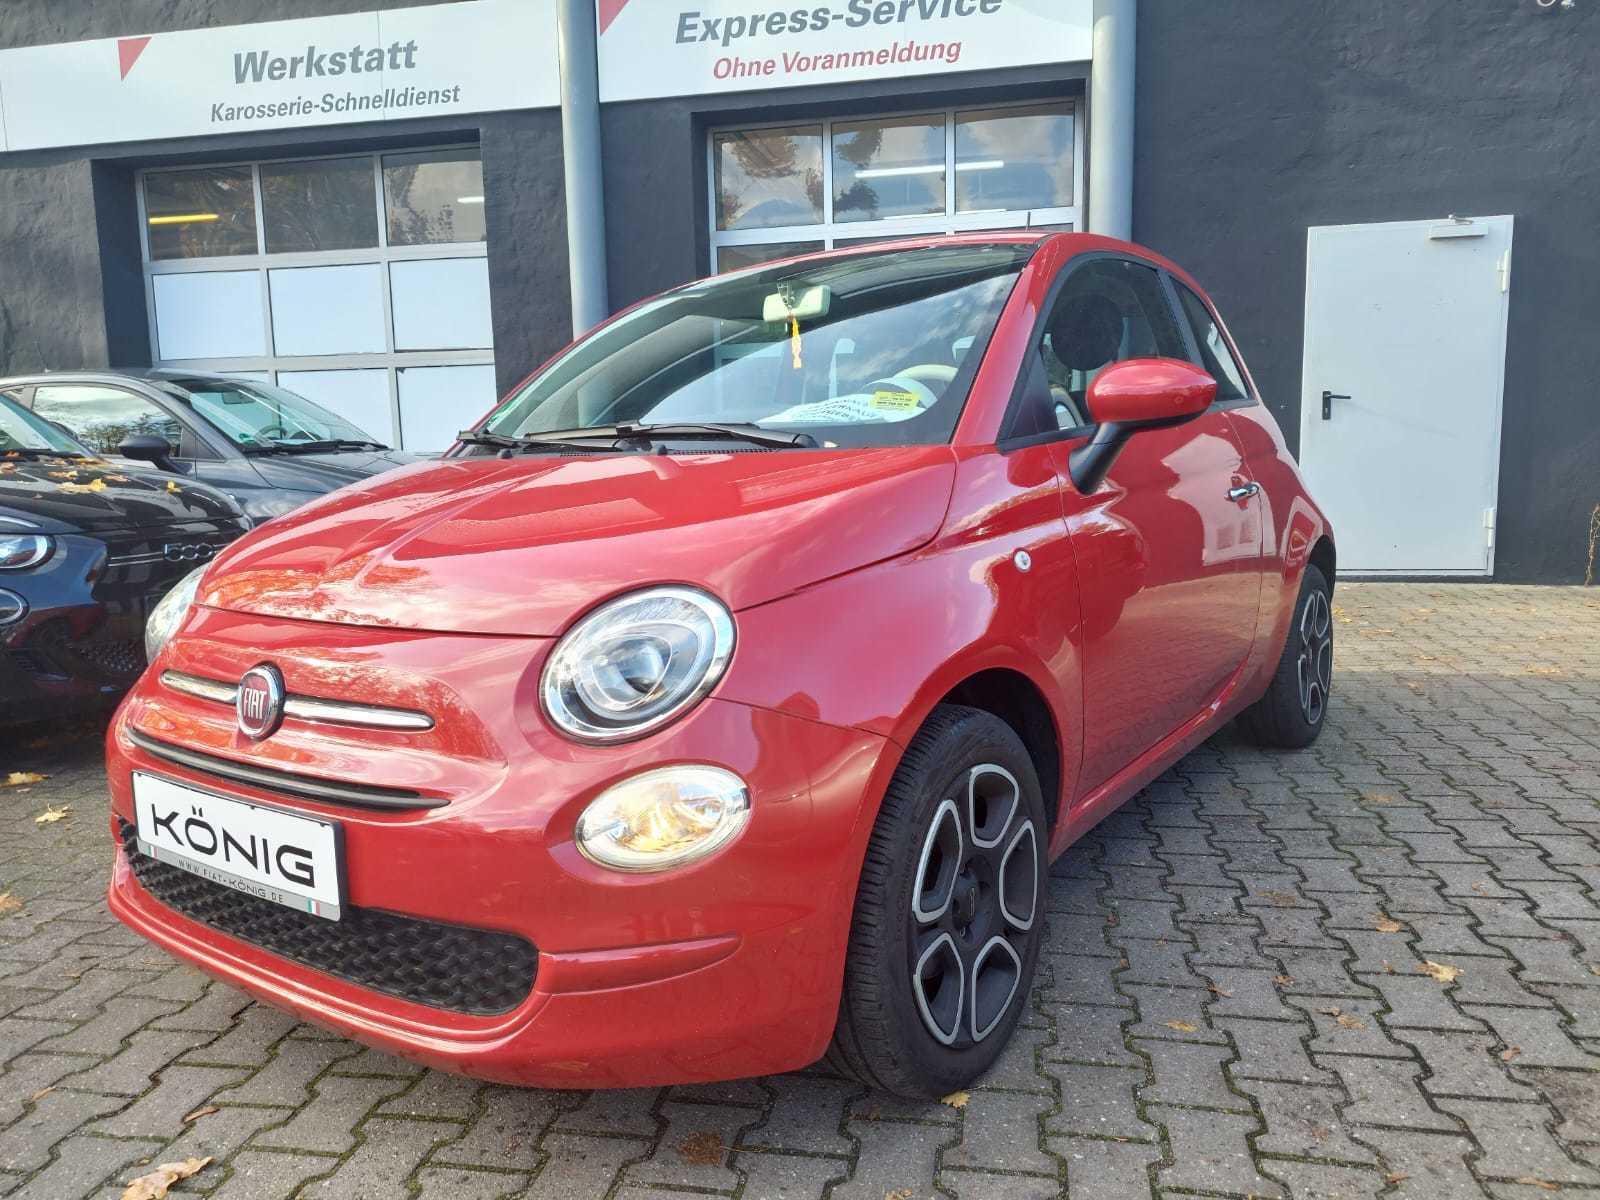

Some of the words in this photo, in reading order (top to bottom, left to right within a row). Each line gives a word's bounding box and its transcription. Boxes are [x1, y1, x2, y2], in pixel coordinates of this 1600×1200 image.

[676, 0, 1001, 47] Express-Service
[234, 39, 418, 84] Werkstatt
[713, 58, 776, 80] Ohne
[782, 40, 962, 74] Voranmeldung
[211, 85, 461, 122] Karosserie-Schnelldienst
[243, 688, 267, 720] FIAT
[151, 803, 316, 889] KÖNIG
